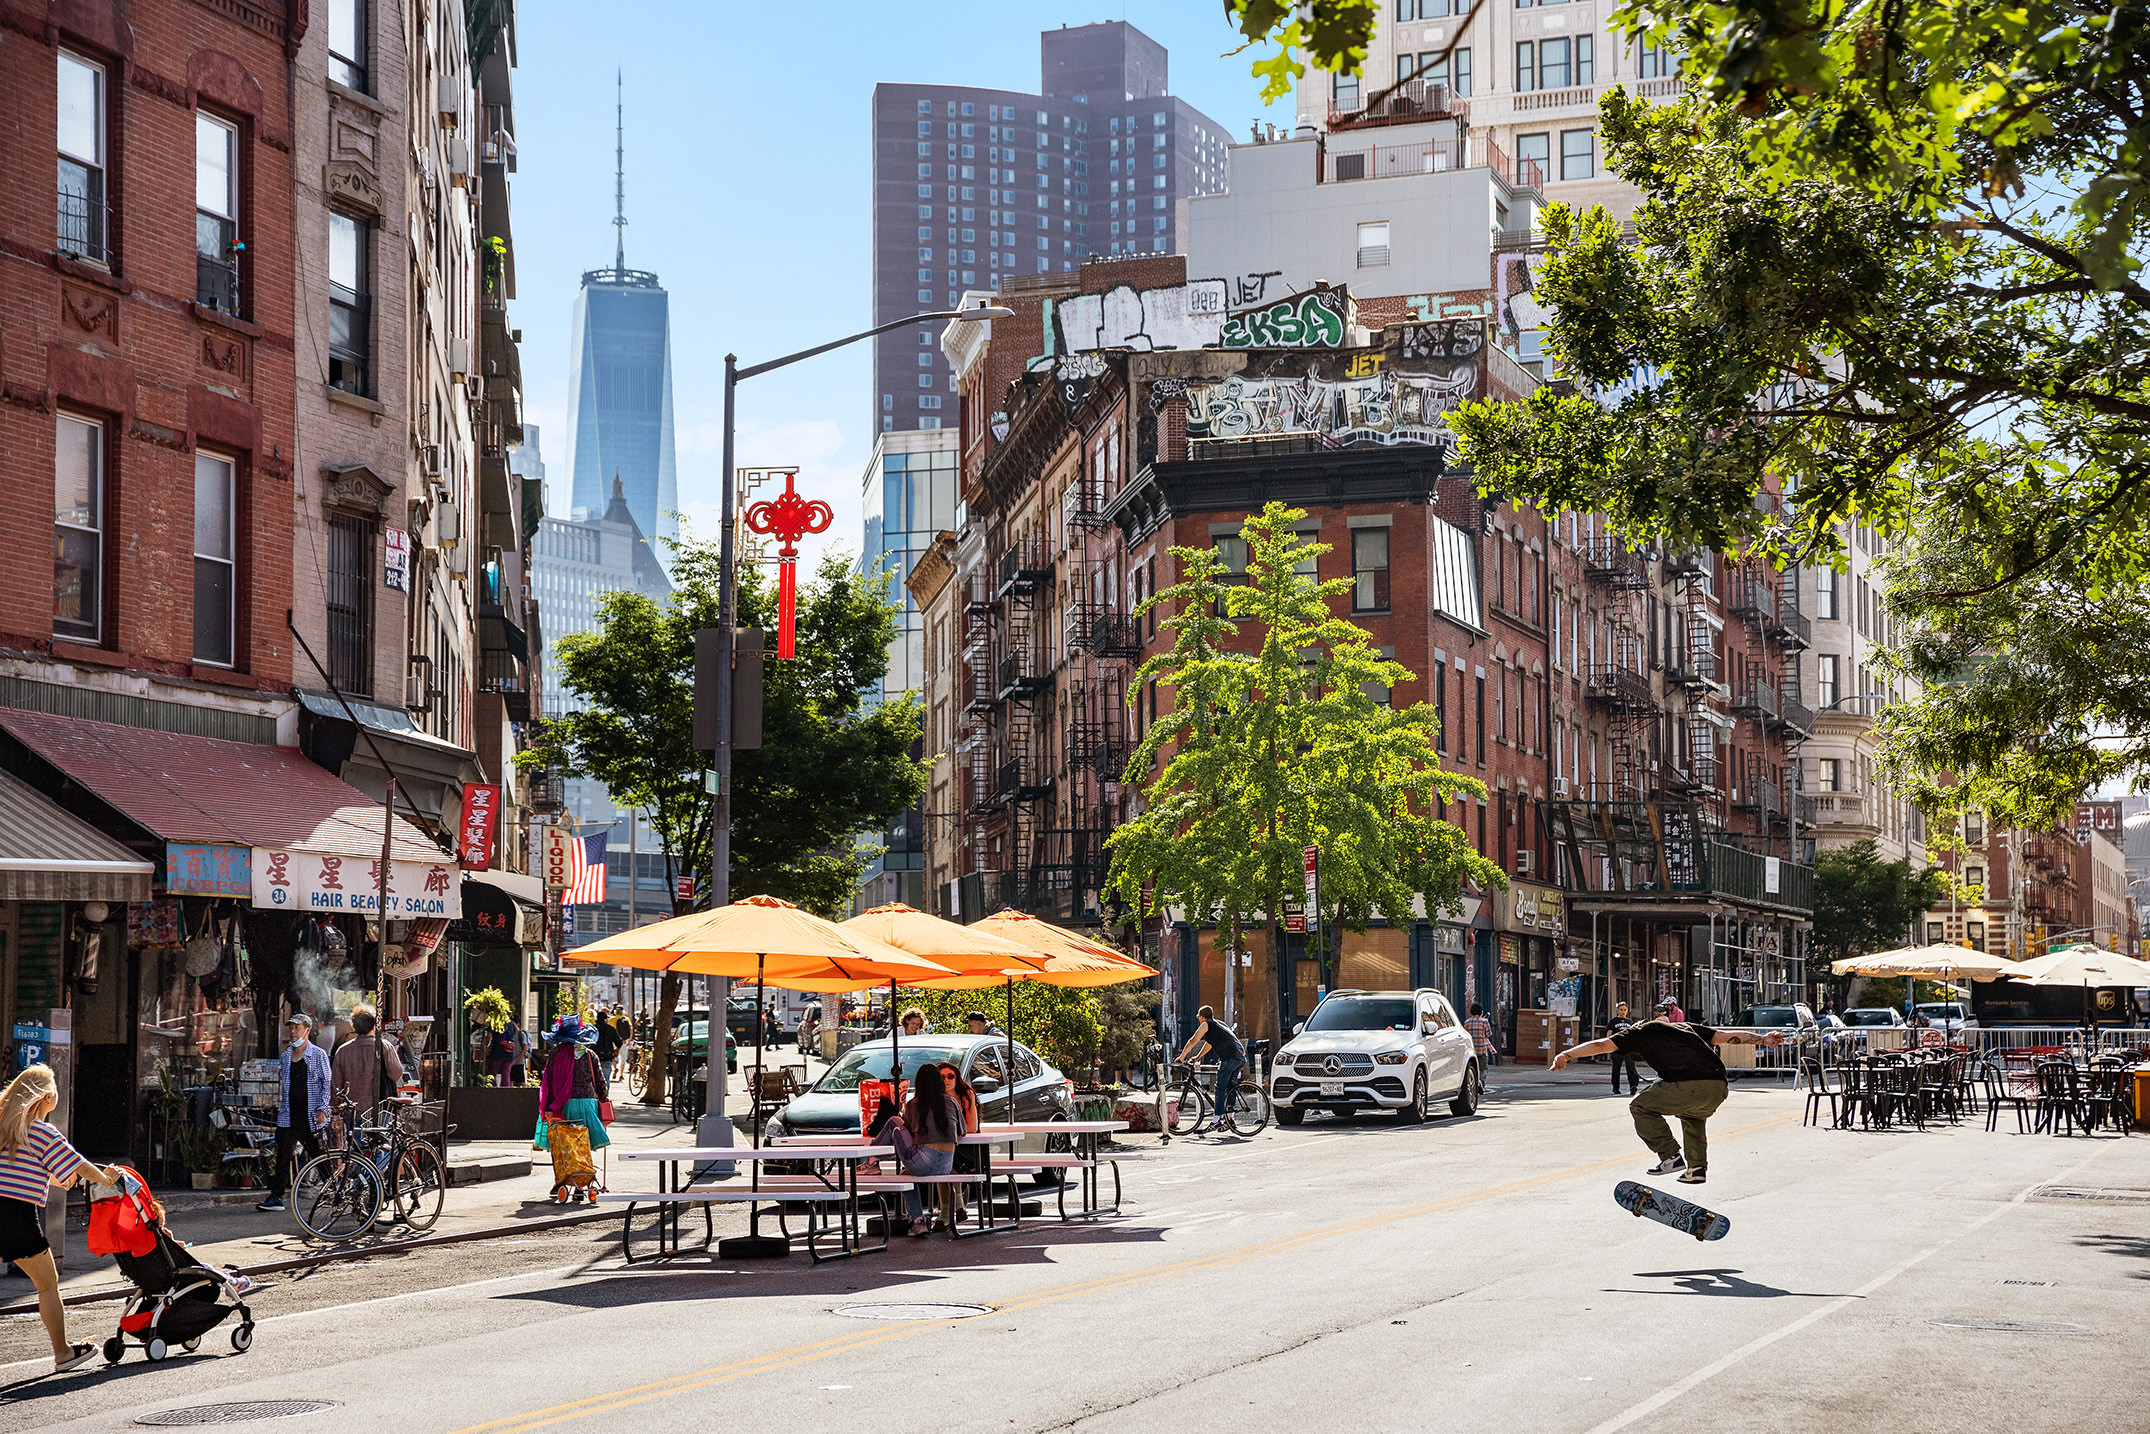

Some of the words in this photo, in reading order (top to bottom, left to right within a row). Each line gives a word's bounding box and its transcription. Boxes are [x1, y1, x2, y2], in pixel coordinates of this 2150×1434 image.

[1232, 270, 1282, 306] JET
[1218, 294, 1345, 349] EKSA
[1345, 354, 1388, 378] JET
[463, 789, 491, 865] 星星髮廊
[550, 829, 564, 884] LIQUOR
[272, 889, 285, 903] 34
[311, 891, 343, 909] HAIR
[405, 898, 444, 914] SALON
[2098, 996, 2114, 1008] ups
[26, 1045, 40, 1068] P
